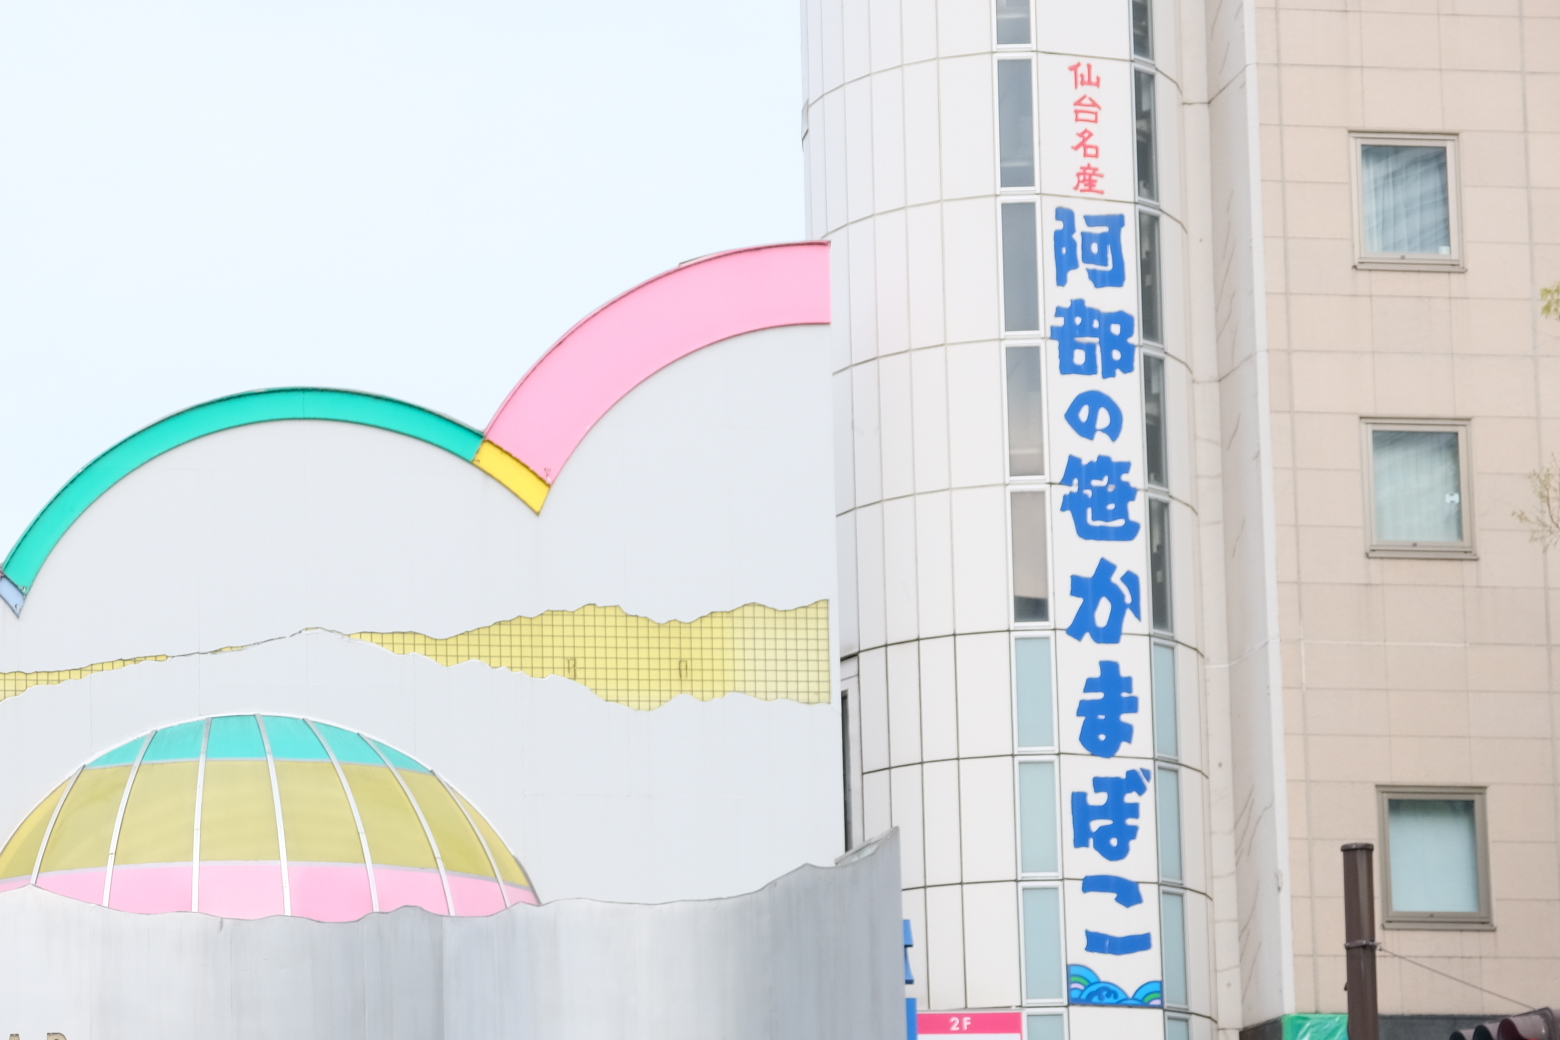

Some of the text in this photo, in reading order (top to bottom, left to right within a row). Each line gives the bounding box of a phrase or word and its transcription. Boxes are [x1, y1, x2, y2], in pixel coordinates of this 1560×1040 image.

[1068, 61, 1105, 195] 仙台名産
[1050, 206, 1152, 955] 阿部の笹かまぼこ
[949, 1017, 972, 1031] 2F
